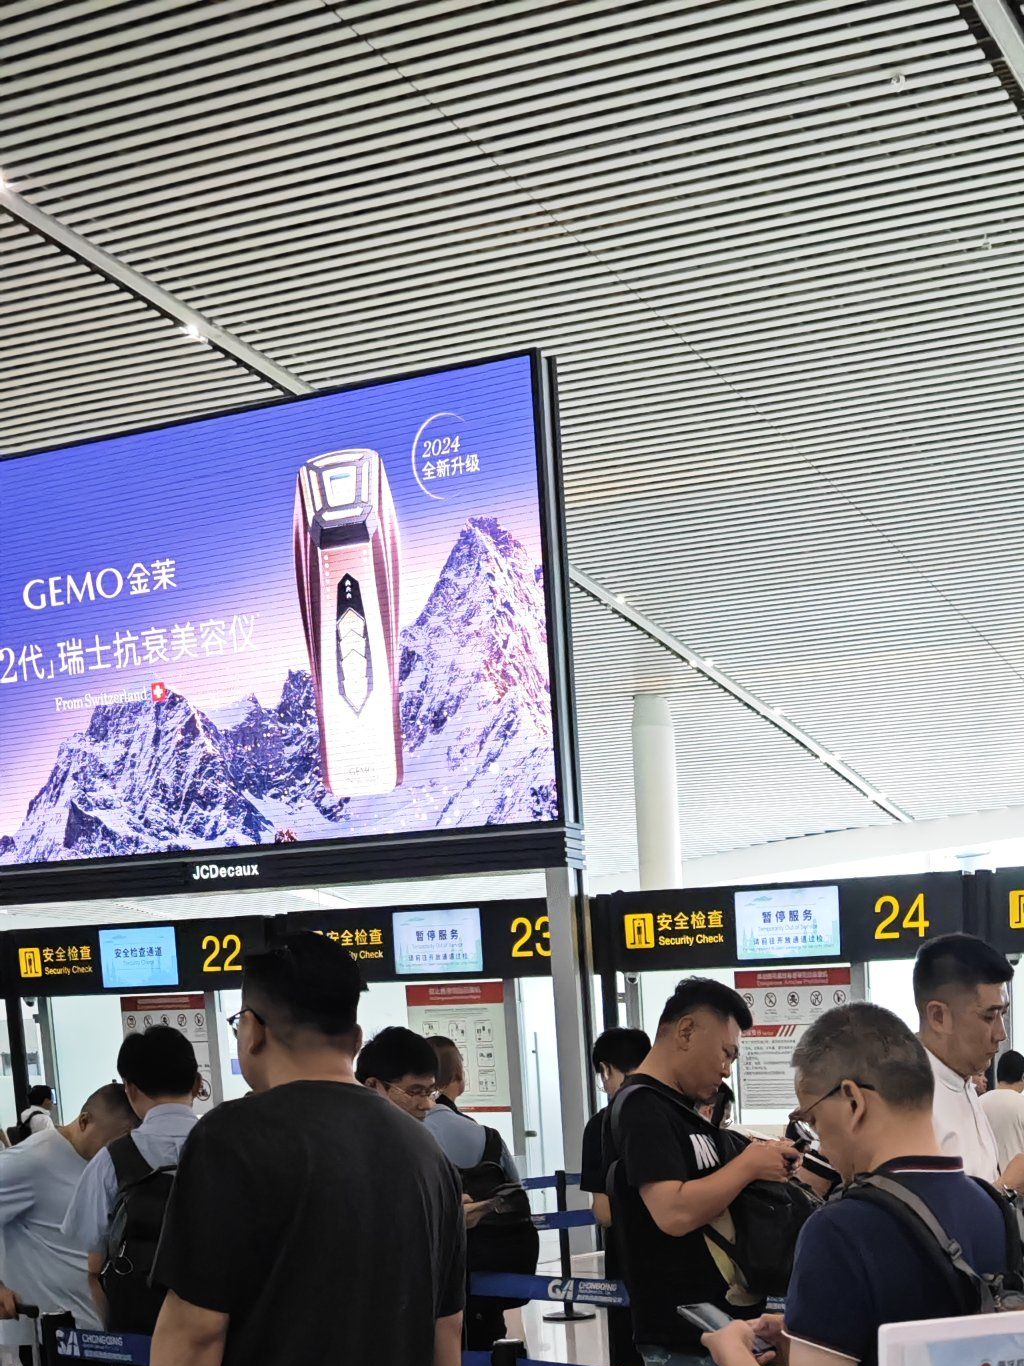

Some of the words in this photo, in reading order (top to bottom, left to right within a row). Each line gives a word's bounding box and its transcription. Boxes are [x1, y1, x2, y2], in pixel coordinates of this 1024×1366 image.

[422, 436, 460, 458] 2024
[422, 453, 480, 480] 全新升级
[55, 695, 84, 712] From
[84, 687, 148, 707] Switzerland
[192, 863, 260, 881] JCDecaux
[656, 909, 725, 931] 安全检查
[761, 908, 813, 924] 暂停服务
[874, 893, 930, 941] 24
[327, 928, 383, 947] 安全检查
[416, 929, 459, 942] 暂停服务
[511, 915, 551, 958] 23
[658, 935, 694, 948] Security
[696, 933, 725, 946] Check
[43, 946, 92, 963] 安全检查
[114, 946, 163, 959] 安全检查通道
[202, 934, 243, 972] 22
[358, 949, 384, 960] Check
[44, 966, 71, 976] Security
[71, 964, 93, 973] Check
